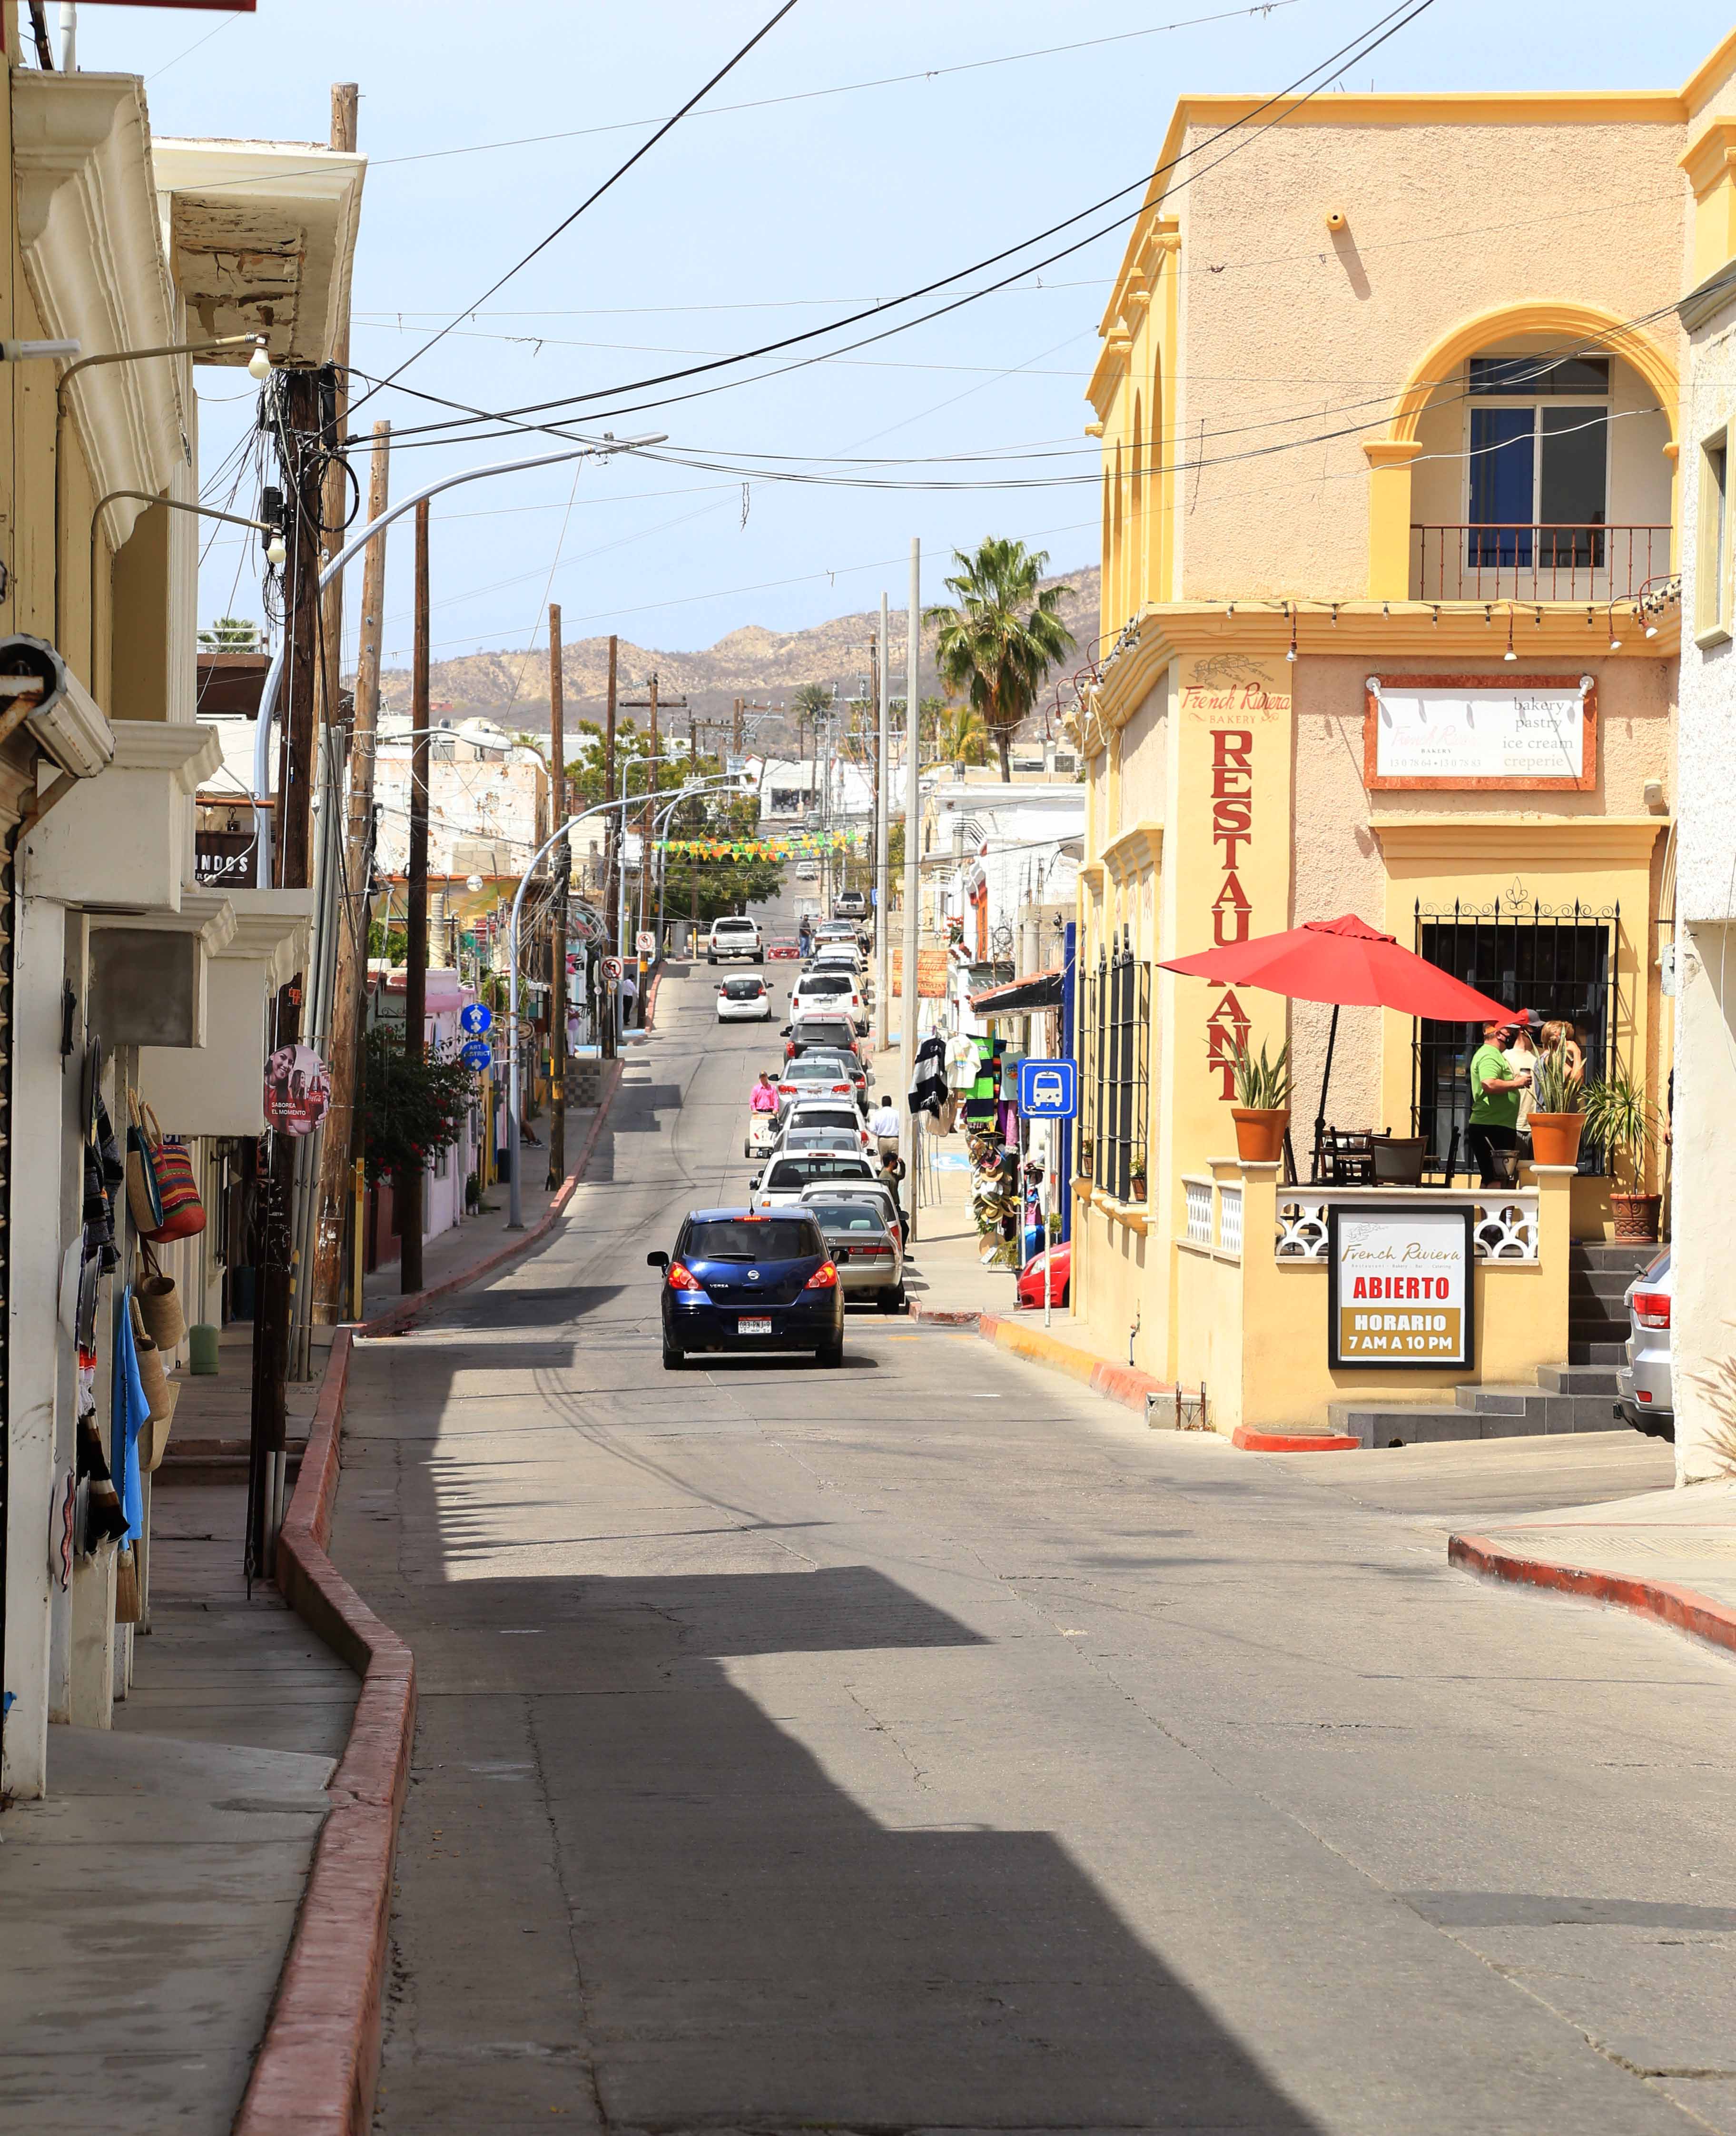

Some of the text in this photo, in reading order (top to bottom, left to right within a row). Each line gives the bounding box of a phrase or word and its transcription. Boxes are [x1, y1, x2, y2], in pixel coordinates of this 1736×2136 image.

[1182, 684, 1237, 709] French
[1240, 682, 1291, 710] Riviera
[1514, 696, 1564, 715] bakery
[1209, 715, 1256, 724] BAKERY
[1516, 718, 1562, 732] pastry
[1503, 736, 1574, 749] ice cream
[1504, 754, 1564, 770] creperie
[1207, 730, 1252, 1100] RESTAUANT
[1341, 1242, 1461, 1262] French Riviera
[1353, 1276, 1449, 1299] ABIERTO
[1355, 1314, 1447, 1331] HORARIO
[1348, 1336, 1452, 1350] 7 AM A 10 PM
